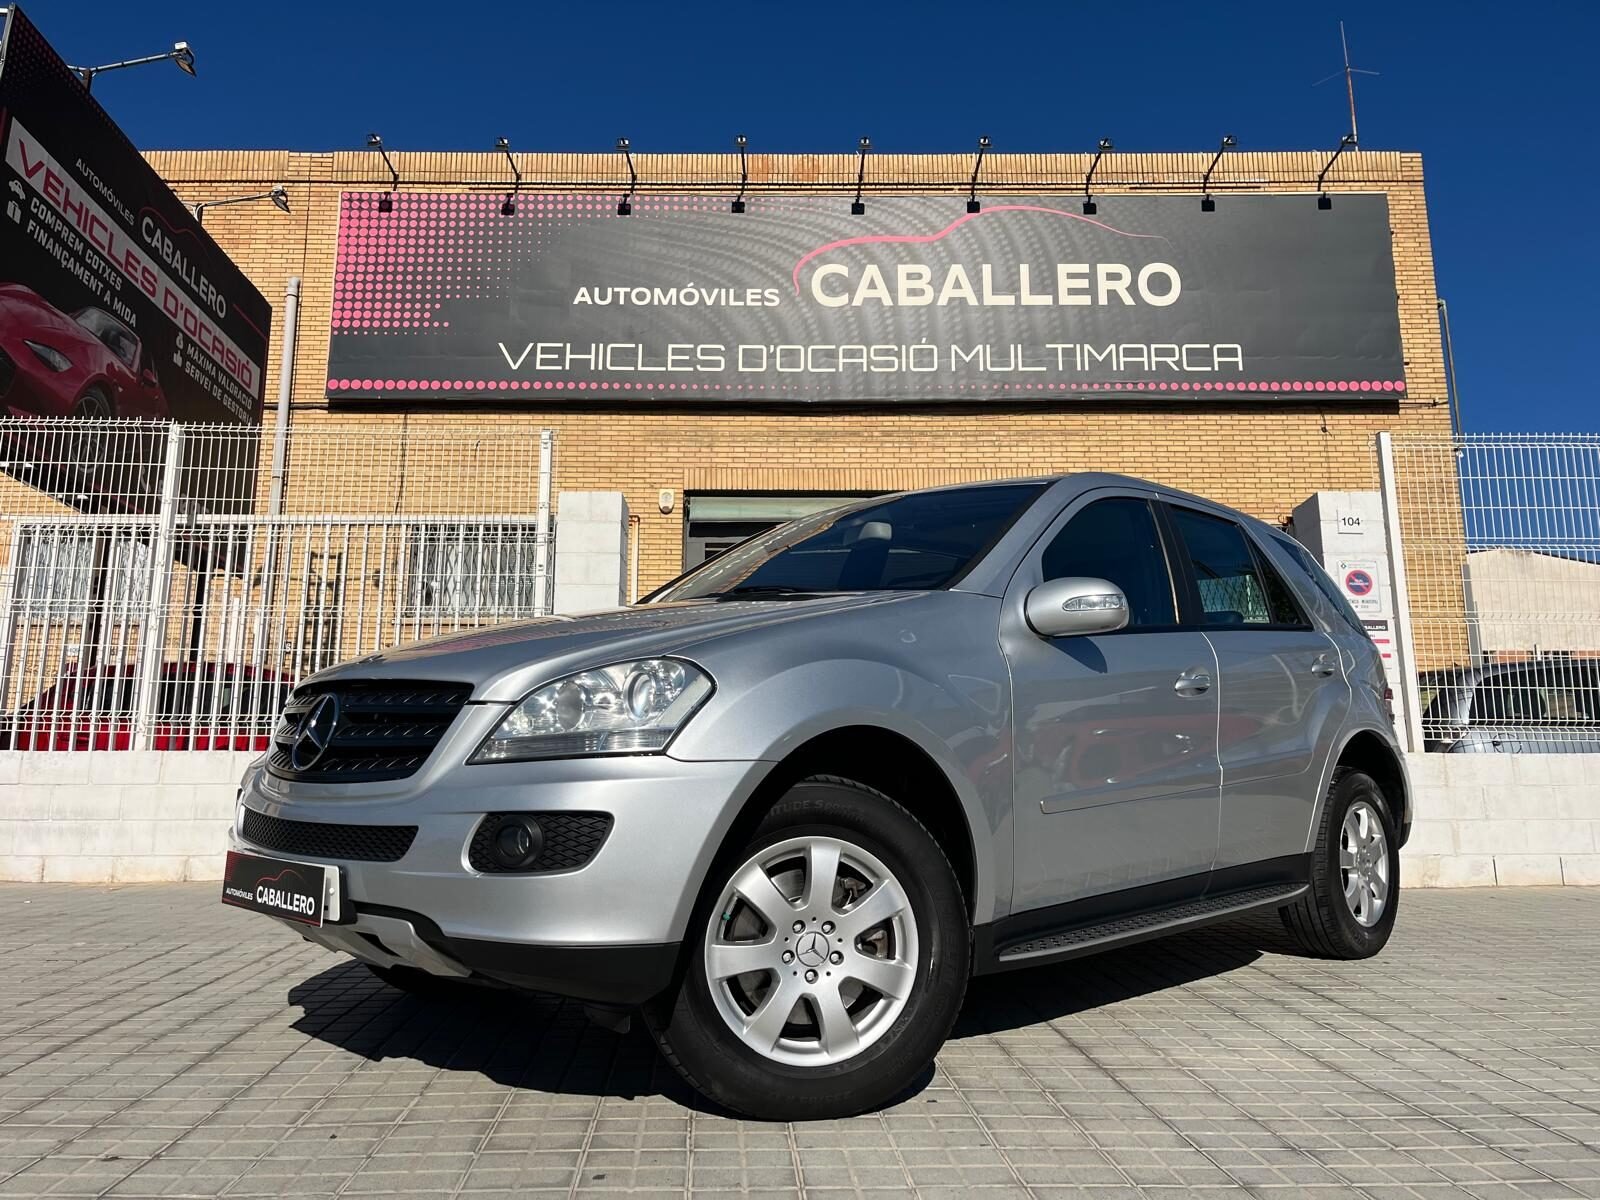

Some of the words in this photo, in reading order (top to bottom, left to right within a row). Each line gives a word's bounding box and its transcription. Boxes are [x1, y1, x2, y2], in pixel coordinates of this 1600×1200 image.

[30, 197, 84, 255] COMPREM
[85, 248, 122, 291] COTXES
[76, 158, 135, 226] AUTOMÓVILES
[142, 216, 227, 319] CABALLERO
[18, 138, 158, 298] VEHICLES
[163, 286, 252, 390] D'OCASIÓ
[27, 219, 104, 296] FINANÇAMENT
[103, 290, 111, 305] A
[113, 297, 137, 327] MIDA
[572, 282, 781, 307] AUTOMÓVILES
[810, 262, 1182, 308] CABALLERO
[498, 342, 726, 372] VEHICLES
[737, 337, 938, 373] D'OCASIÓ
[951, 342, 1244, 372] MULTIMARCA
[184, 361, 211, 392] SERVEI
[212, 385, 222, 402] DE
[218, 371, 253, 411] VALORACIÓ
[1341, 516, 1361, 526] 104
[225, 887, 254, 901] AUTOMÓVILES
[256, 885, 315, 916] CABALLERO
